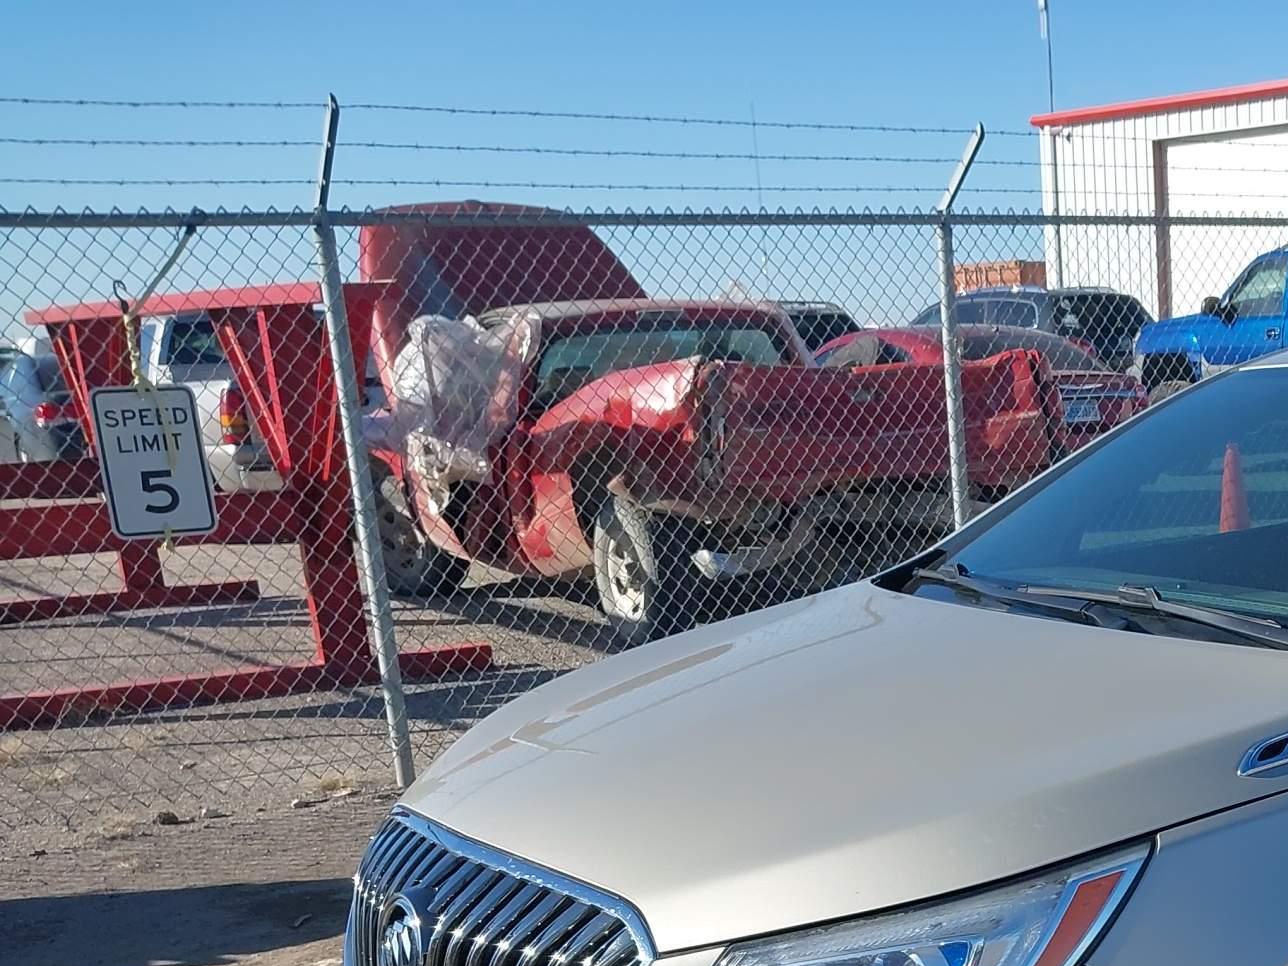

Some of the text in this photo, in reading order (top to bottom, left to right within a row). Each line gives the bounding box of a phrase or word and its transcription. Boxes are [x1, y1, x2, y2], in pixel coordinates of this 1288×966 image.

[104, 407, 188, 428] SPEED
[117, 433, 182, 454] LIMIT
[140, 470, 180, 514] 5
